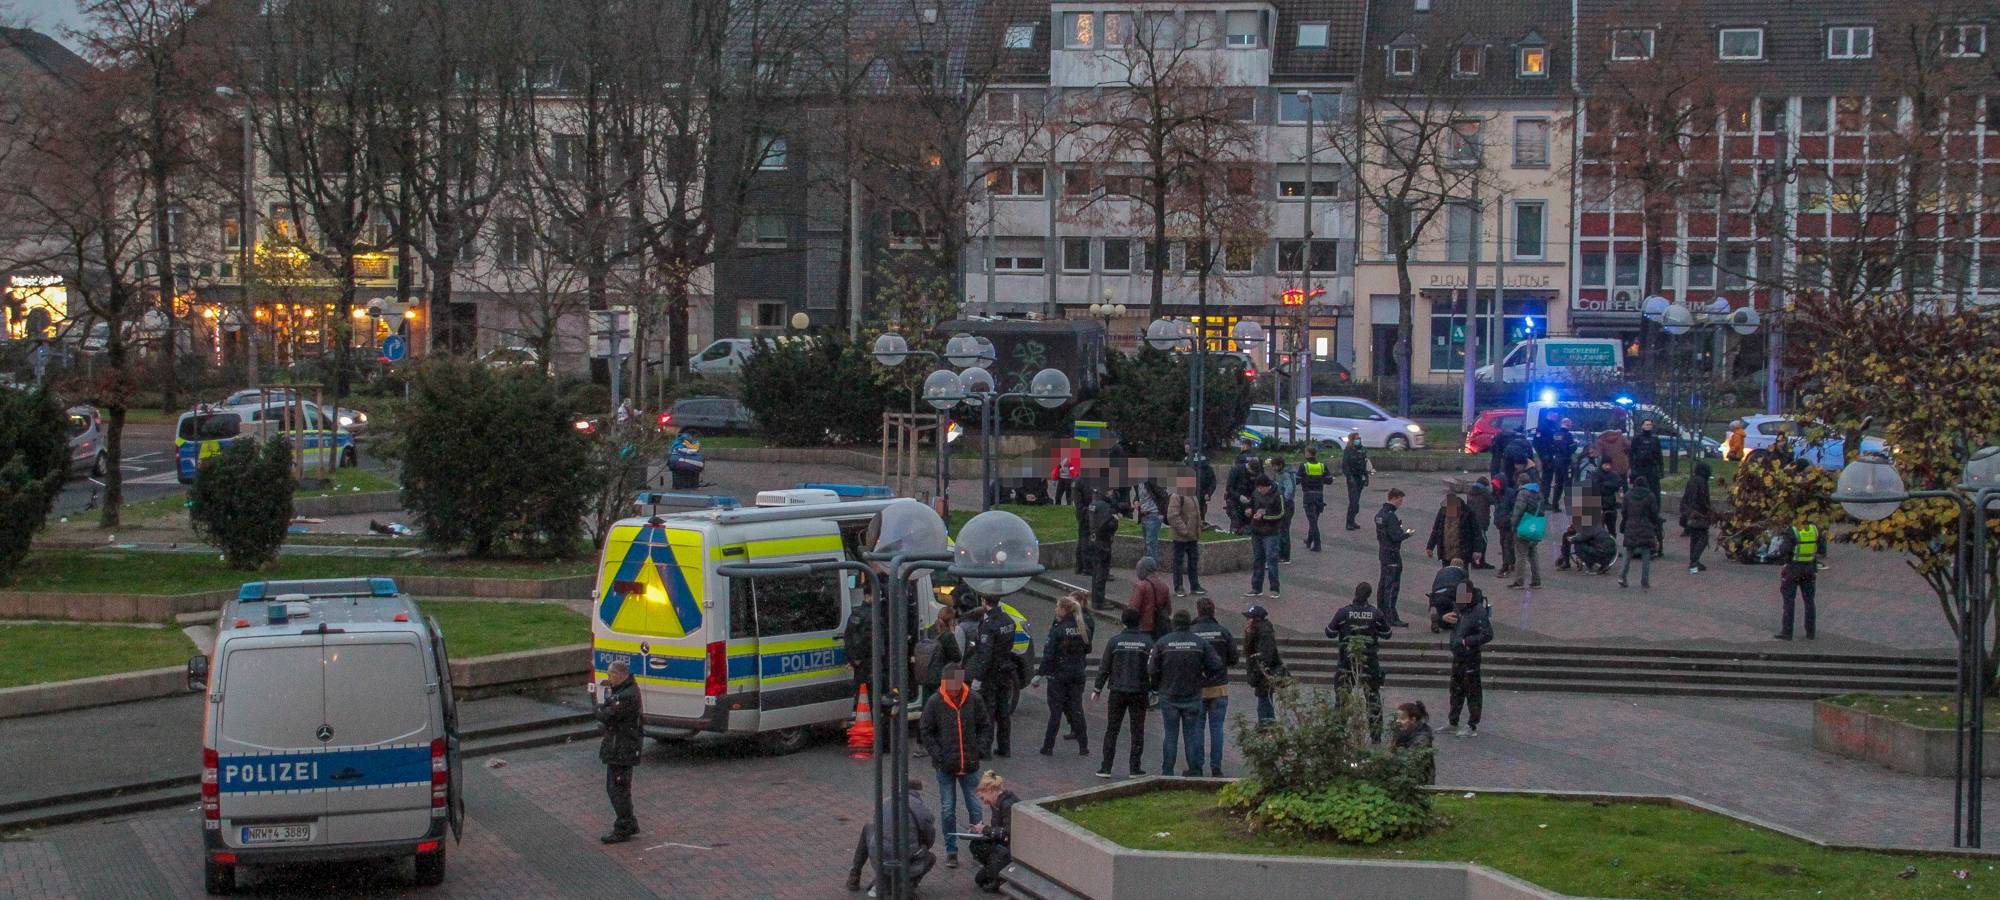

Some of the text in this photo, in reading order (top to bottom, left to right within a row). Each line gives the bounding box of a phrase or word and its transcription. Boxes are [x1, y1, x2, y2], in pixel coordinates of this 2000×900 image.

[1349, 611, 1373, 619] POLIZEI
[781, 650, 835, 673] POLIZEI
[226, 761, 319, 784] POLIZEI
